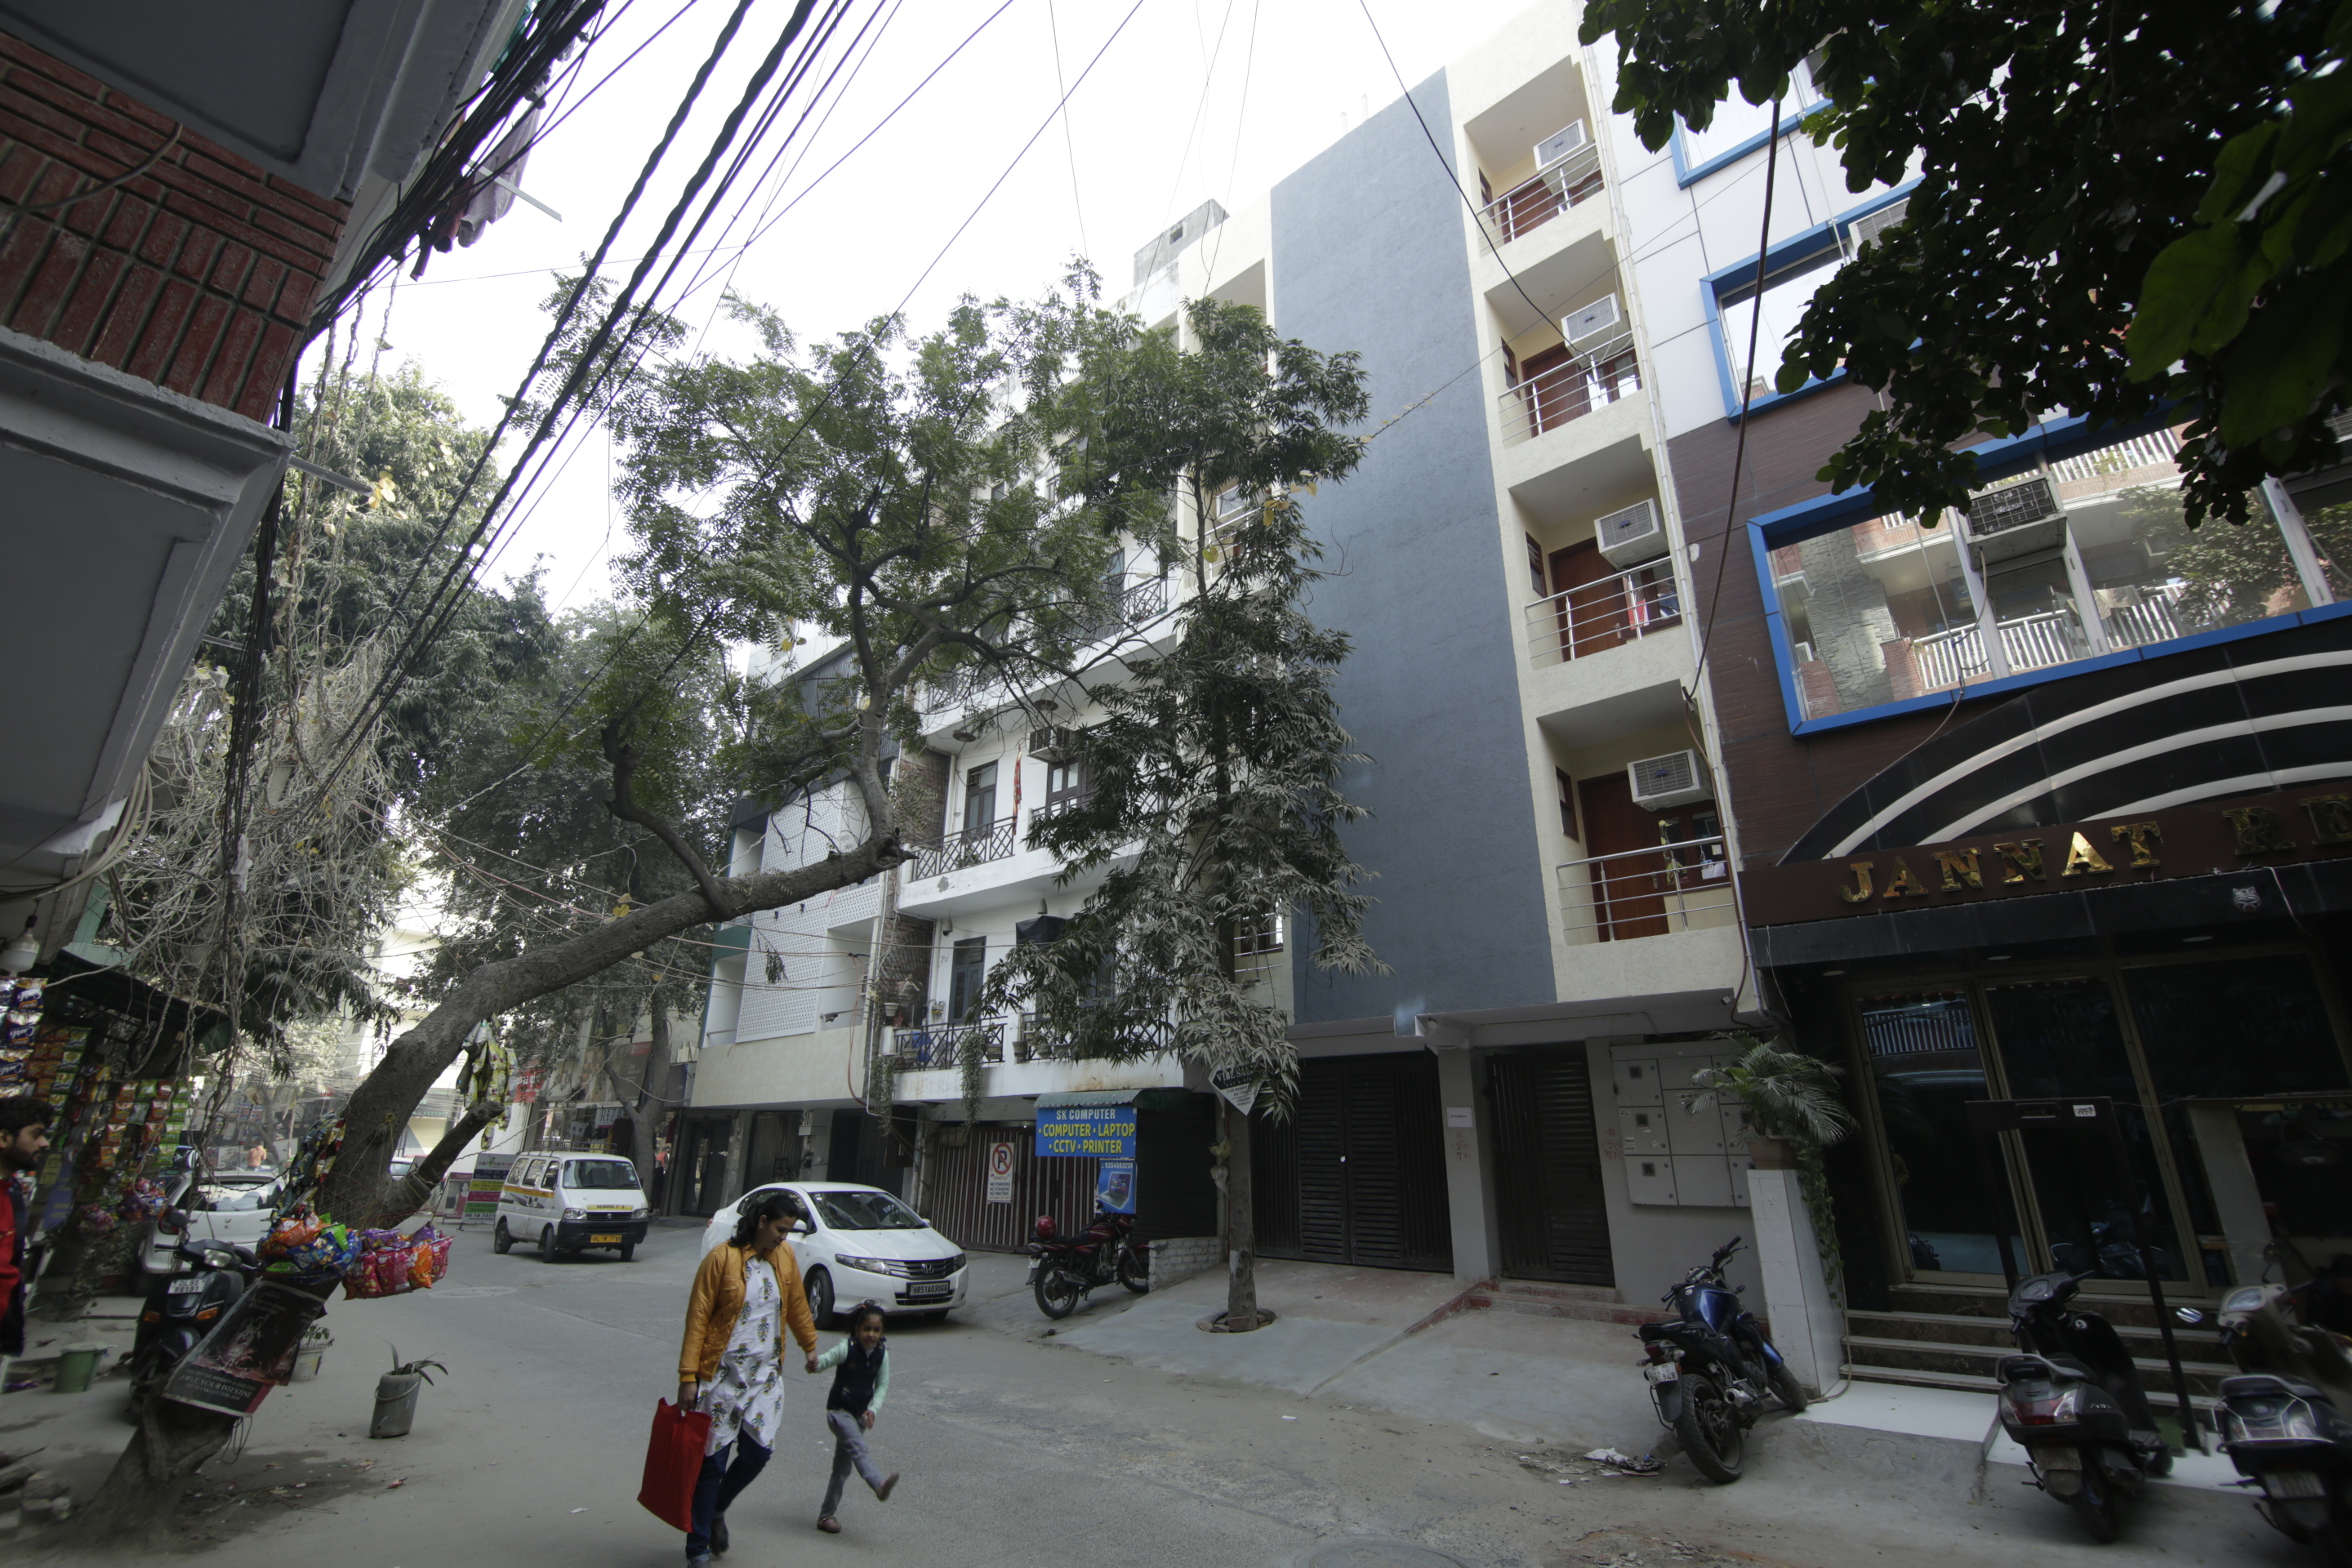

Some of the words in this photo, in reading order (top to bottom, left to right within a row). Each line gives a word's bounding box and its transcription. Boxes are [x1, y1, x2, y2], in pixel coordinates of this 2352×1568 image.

[1838, 820, 2163, 903] JANNAT
[1056, 1110, 1067, 1120] SK
[1069, 1108, 1116, 1120] COMPUTER
[1043, 1123, 1092, 1138] COMPUTER
[1098, 1122, 1135, 1138] LAPTOP
[1054, 1139, 1076, 1153] CCTV
[1083, 1139, 1122, 1154] PRINTER
[200, 1378, 221, 1390] YOUR
[221, 1383, 253, 1398] INTESTINE
